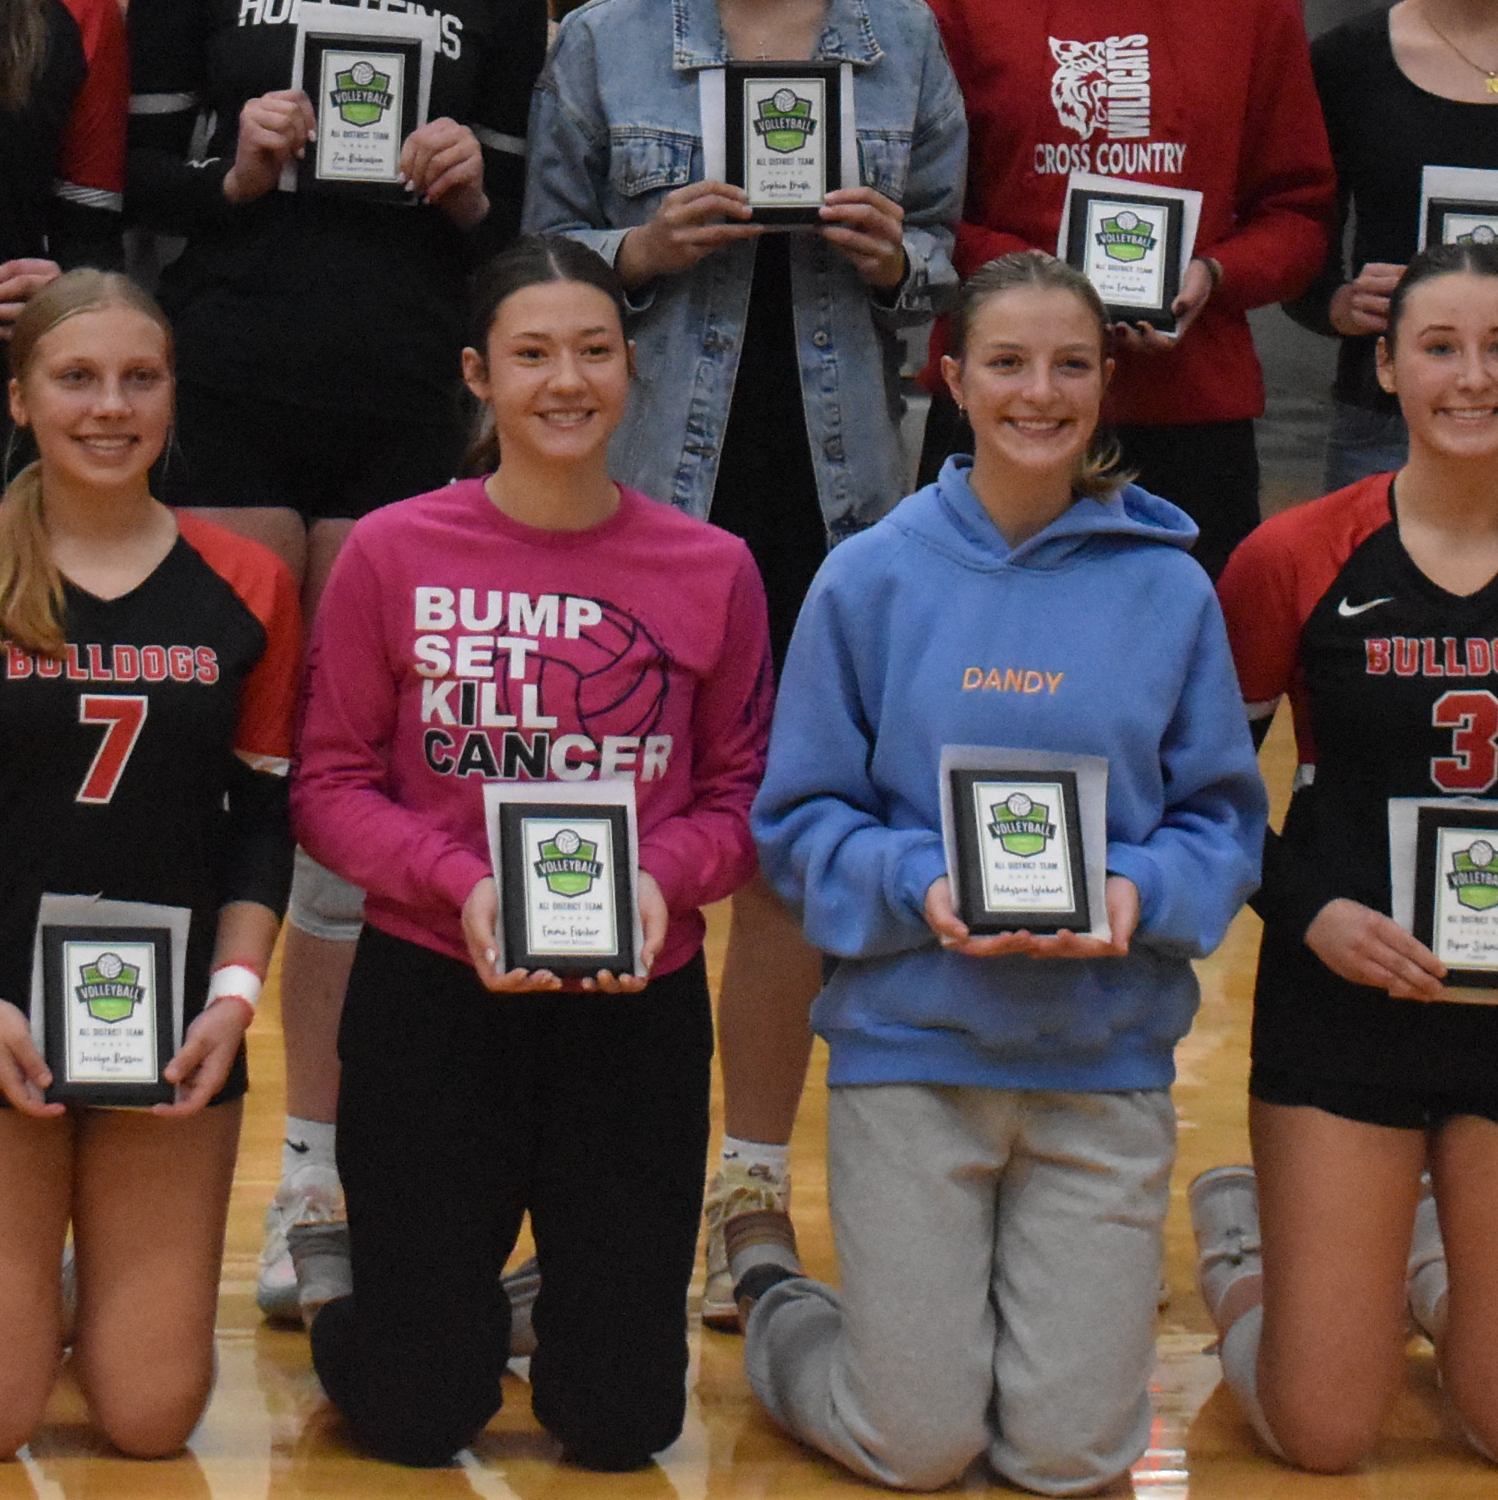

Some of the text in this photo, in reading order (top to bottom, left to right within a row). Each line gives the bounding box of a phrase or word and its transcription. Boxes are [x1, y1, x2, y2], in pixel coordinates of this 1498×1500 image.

[335, 90, 389, 107] VOLLEYBALL
[1104, 33, 1151, 139] WILDCATS
[758, 117, 812, 133] VOLLEYBALL
[1034, 142, 1187, 174] CROSS COUNTRY
[1100, 232, 1153, 249] VOLLEYBALL
[415, 586, 602, 639] BUMP
[413, 635, 539, 679] SET
[962, 666, 1065, 695] DANDY
[421, 679, 558, 729] KILL
[76, 694, 148, 804] 7
[423, 728, 673, 782] CANCER
[993, 820, 1051, 837] VOLLEYBALL
[539, 859, 598, 876] VOLLEYBALL
[81, 984, 140, 1001] VOLLEYBALL
